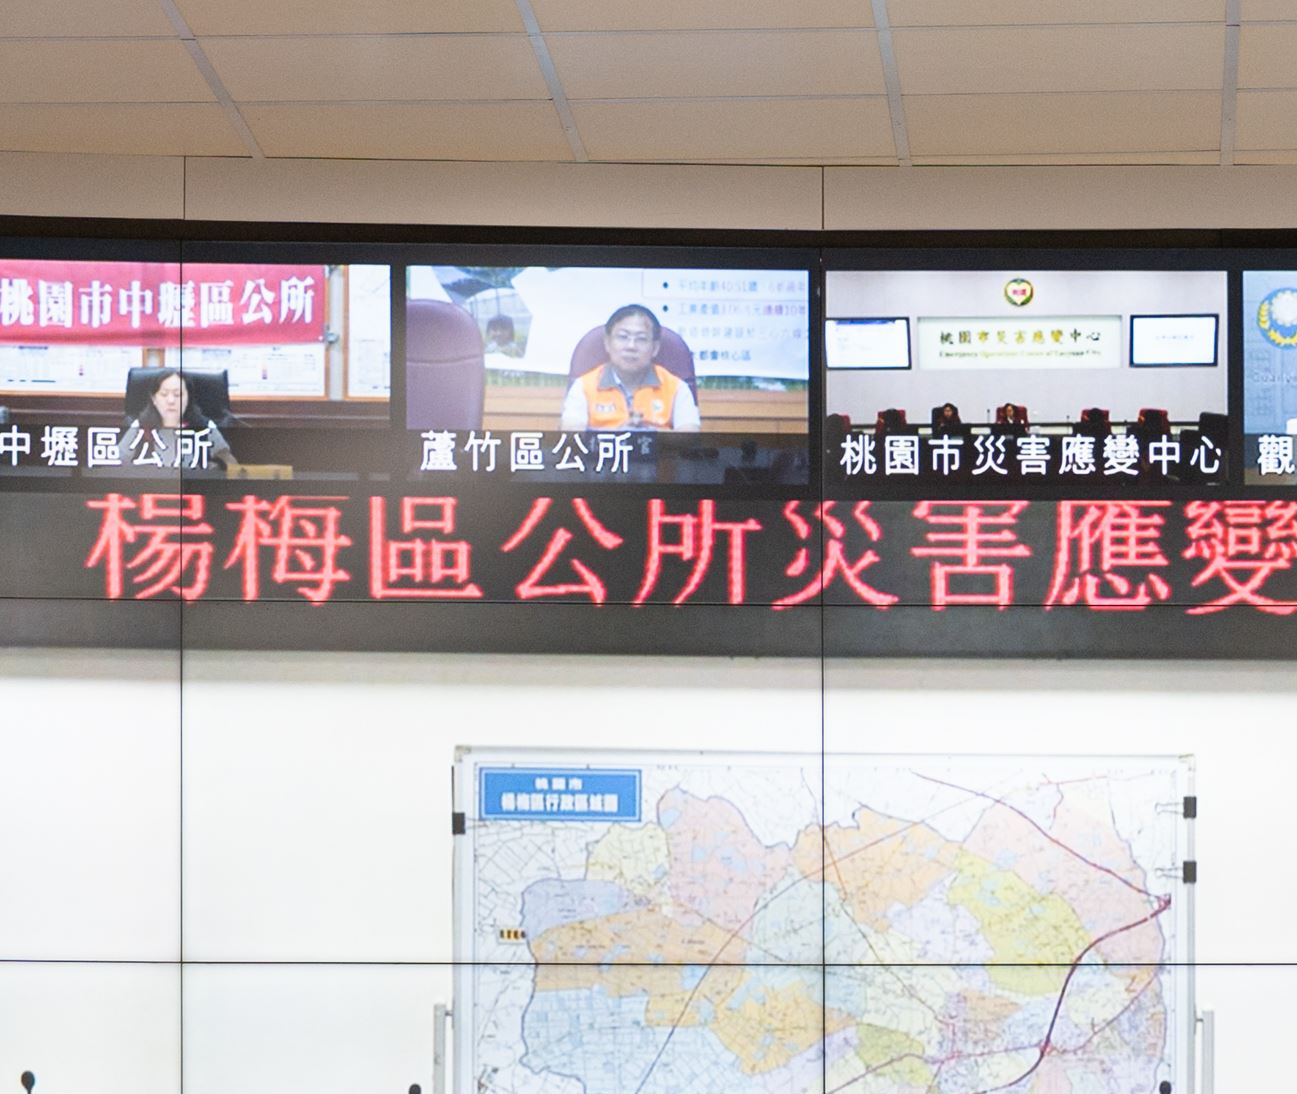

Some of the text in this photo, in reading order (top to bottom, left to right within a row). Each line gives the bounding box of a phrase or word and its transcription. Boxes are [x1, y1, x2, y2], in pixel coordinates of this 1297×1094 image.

[420, 430, 634, 473] 蘆竹區公所
[840, 434, 1222, 476] 桃園市災害應變中心
